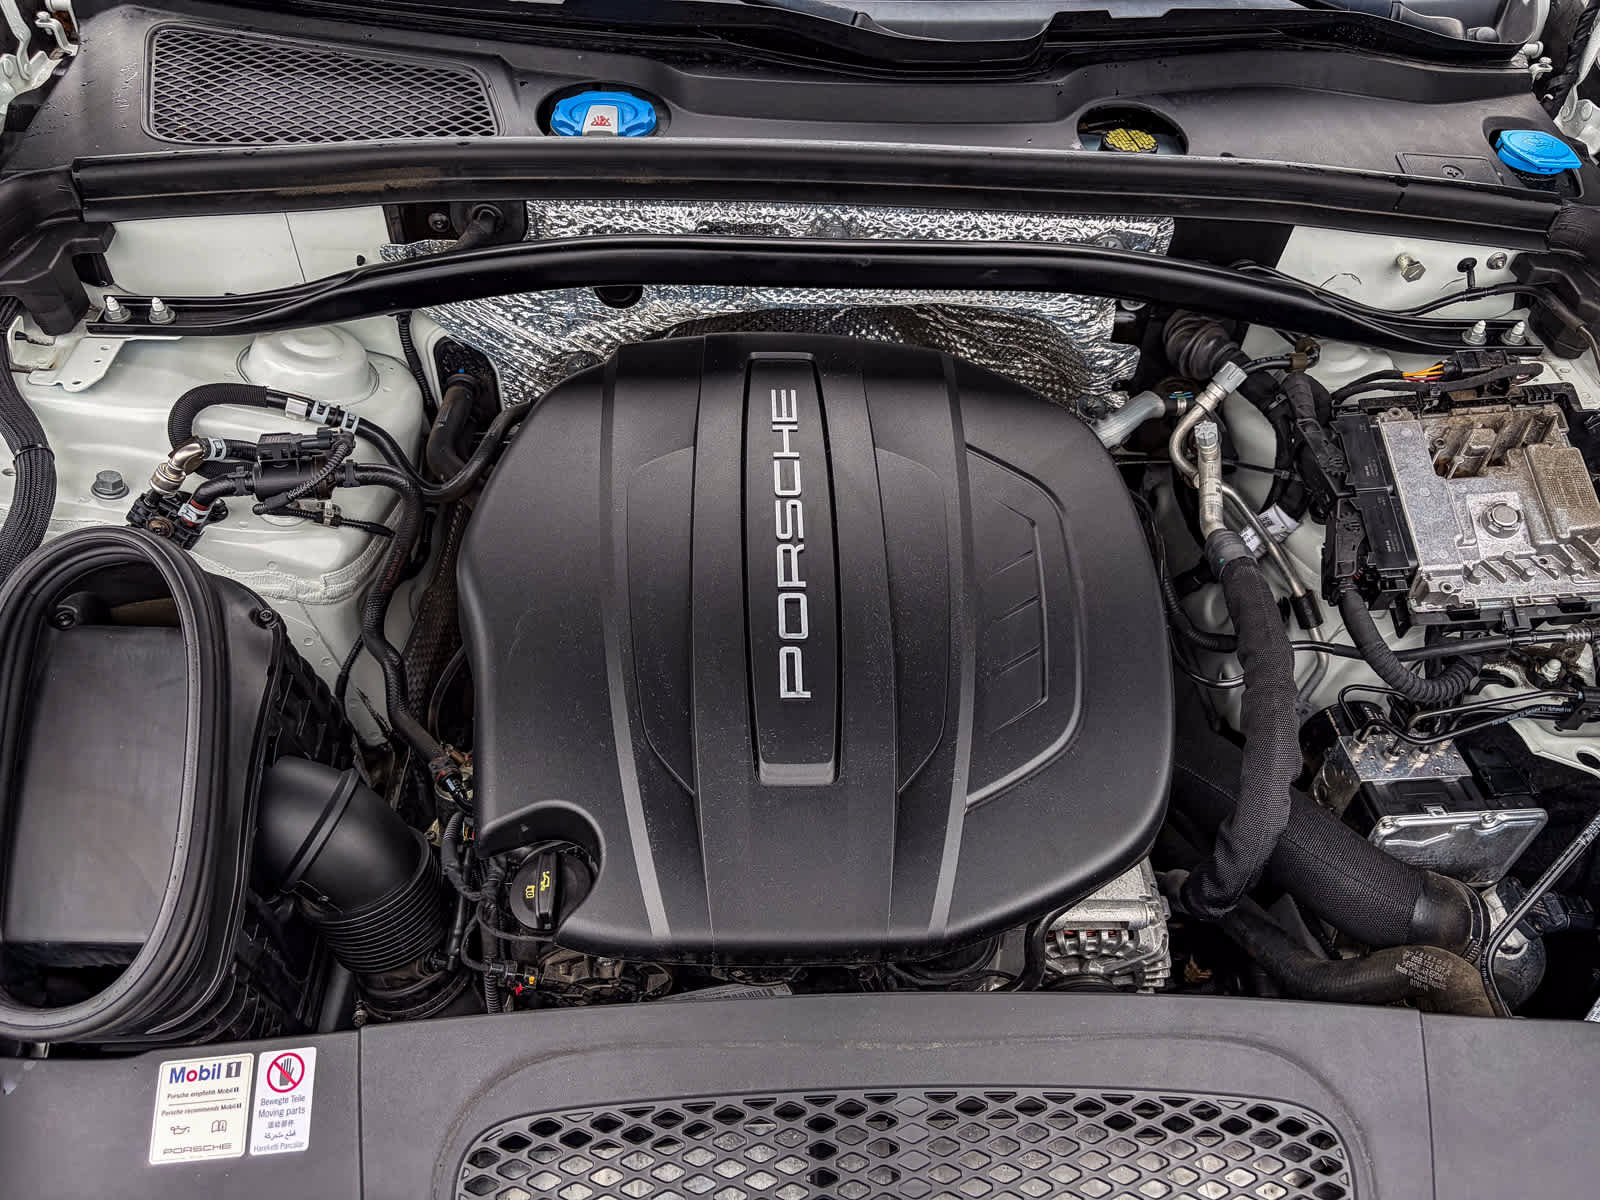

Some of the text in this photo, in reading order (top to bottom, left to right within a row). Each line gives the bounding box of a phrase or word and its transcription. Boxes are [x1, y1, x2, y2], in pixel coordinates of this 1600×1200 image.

[771, 390, 811, 698] PORSCHE
[169, 1061, 242, 1084] Mobil 1
[167, 1090, 189, 1099] Porsche
[260, 1094, 306, 1106] Bewegte Teile
[161, 1108, 184, 1117] Porsche
[258, 1106, 305, 1118] Moving parts
[163, 1143, 232, 1155] PORSCHE
